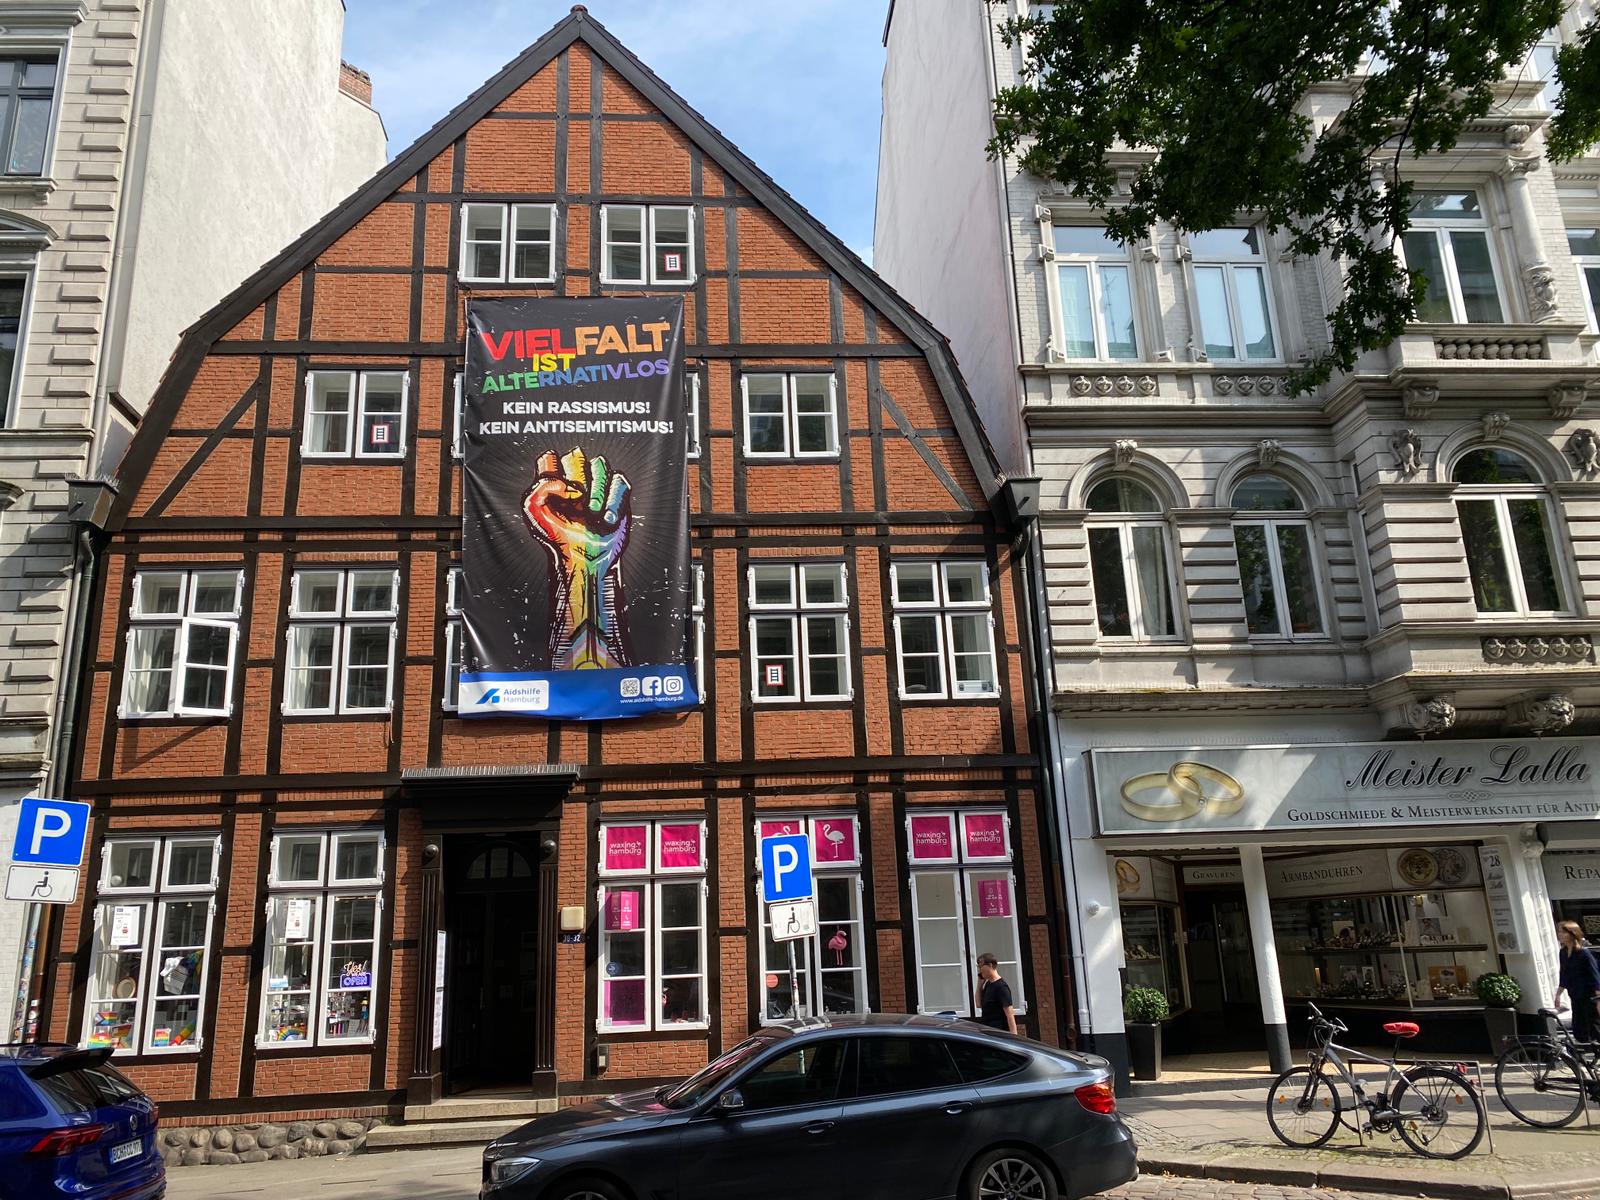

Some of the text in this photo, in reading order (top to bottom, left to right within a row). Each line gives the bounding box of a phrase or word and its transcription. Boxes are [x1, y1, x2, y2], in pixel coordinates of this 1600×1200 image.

[479, 322, 671, 361] VIELFALT
[532, 353, 576, 372] IST
[481, 358, 671, 394] ALTERNATIVLOS
[502, 401, 651, 415] KEIN RASSISMUS!
[479, 420, 674, 435] KEIN ANTISEMITISMUS!
[503, 696, 540, 704] Hamburg
[1345, 745, 1588, 788] Meister Lalla
[1391, 807, 1404, 818] &
[30, 807, 72, 855] P
[915, 837, 947, 845] hamburg
[969, 835, 1001, 843] hamburg
[608, 847, 642, 855] hamburg
[663, 845, 696, 853] hamburg
[1490, 855, 1501, 867] 28
[772, 844, 799, 893] P
[343, 976, 367, 985] OPEN
